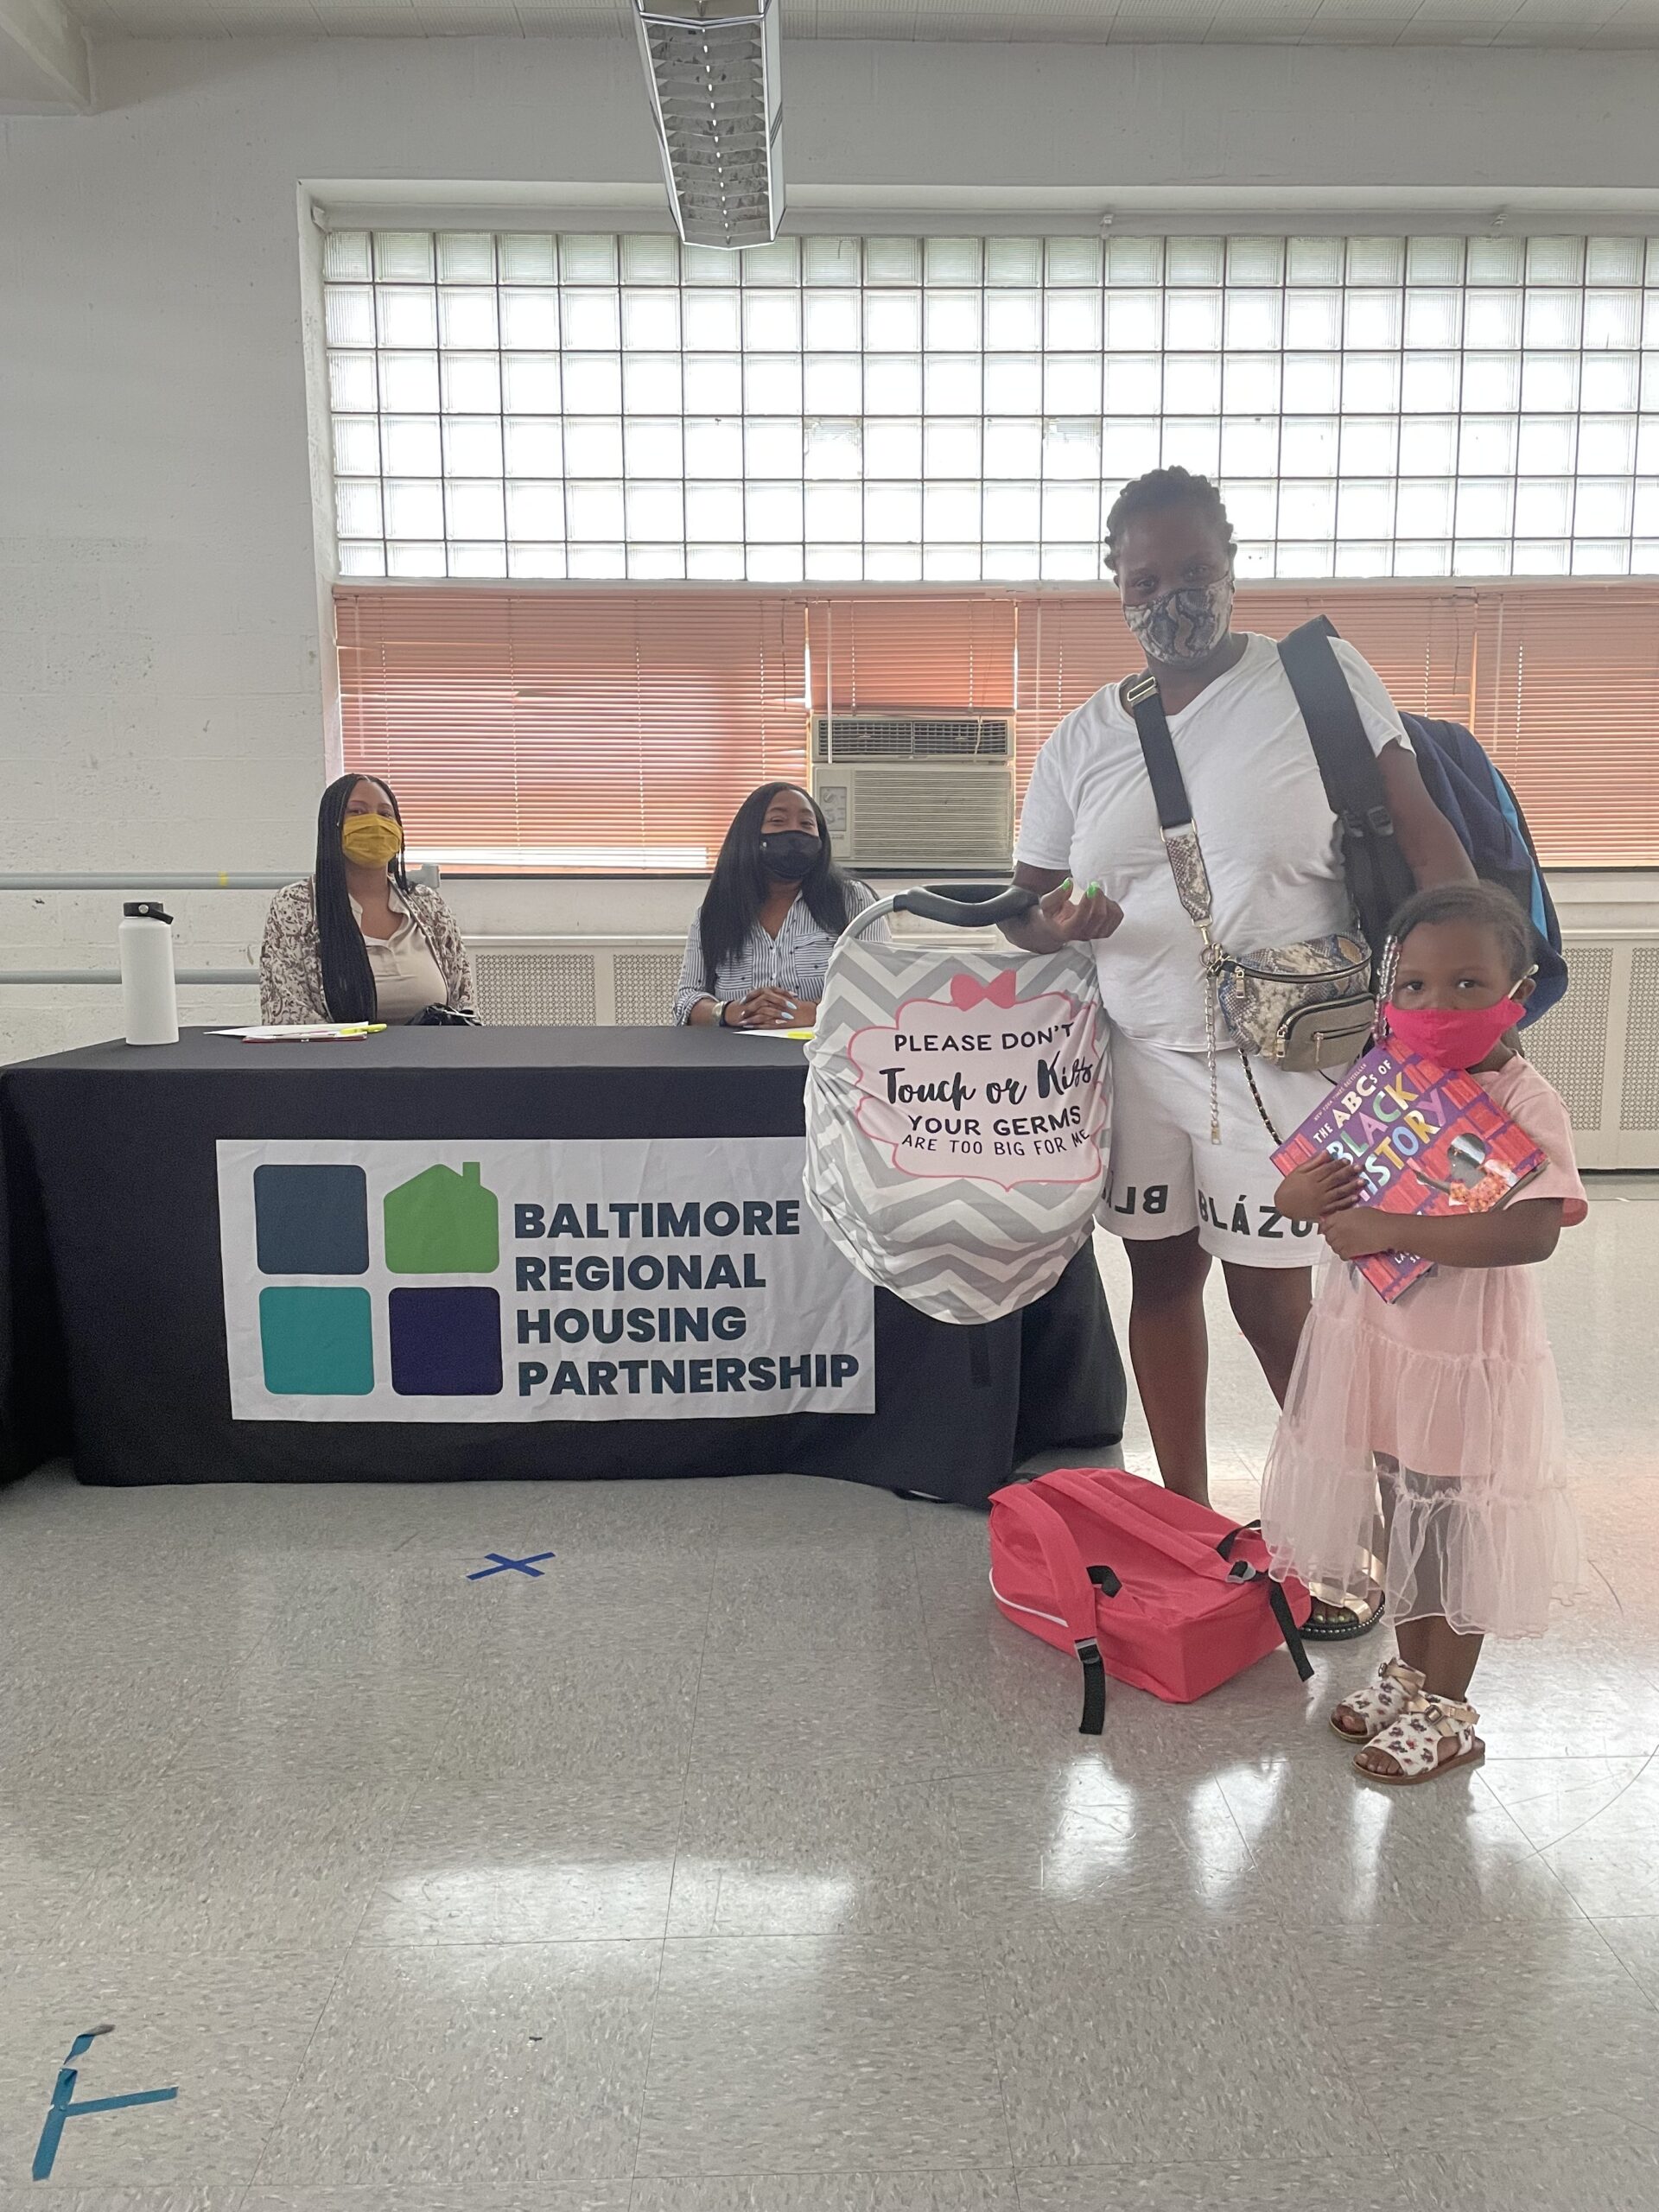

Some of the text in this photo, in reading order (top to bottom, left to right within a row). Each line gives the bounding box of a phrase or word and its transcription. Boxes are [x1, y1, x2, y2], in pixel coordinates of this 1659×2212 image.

[894, 1021, 1074, 1052] PLEASE DON'T
[879, 1050, 1093, 1111] Touch or Kiss
[907, 1105, 1082, 1136] YOUR GERMS
[1313, 1059, 1392, 1143] THE ABCs OF
[901, 1128, 1091, 1156] ARE TOO BIG FOR ME
[1359, 1088, 1446, 1202] ISTORY
[514, 1199, 800, 1239] BALTIMORE
[515, 1253, 766, 1292] REGIONAL
[517, 1306, 747, 1344] HOUSING
[518, 1353, 860, 1397] PARTNERSHIP
